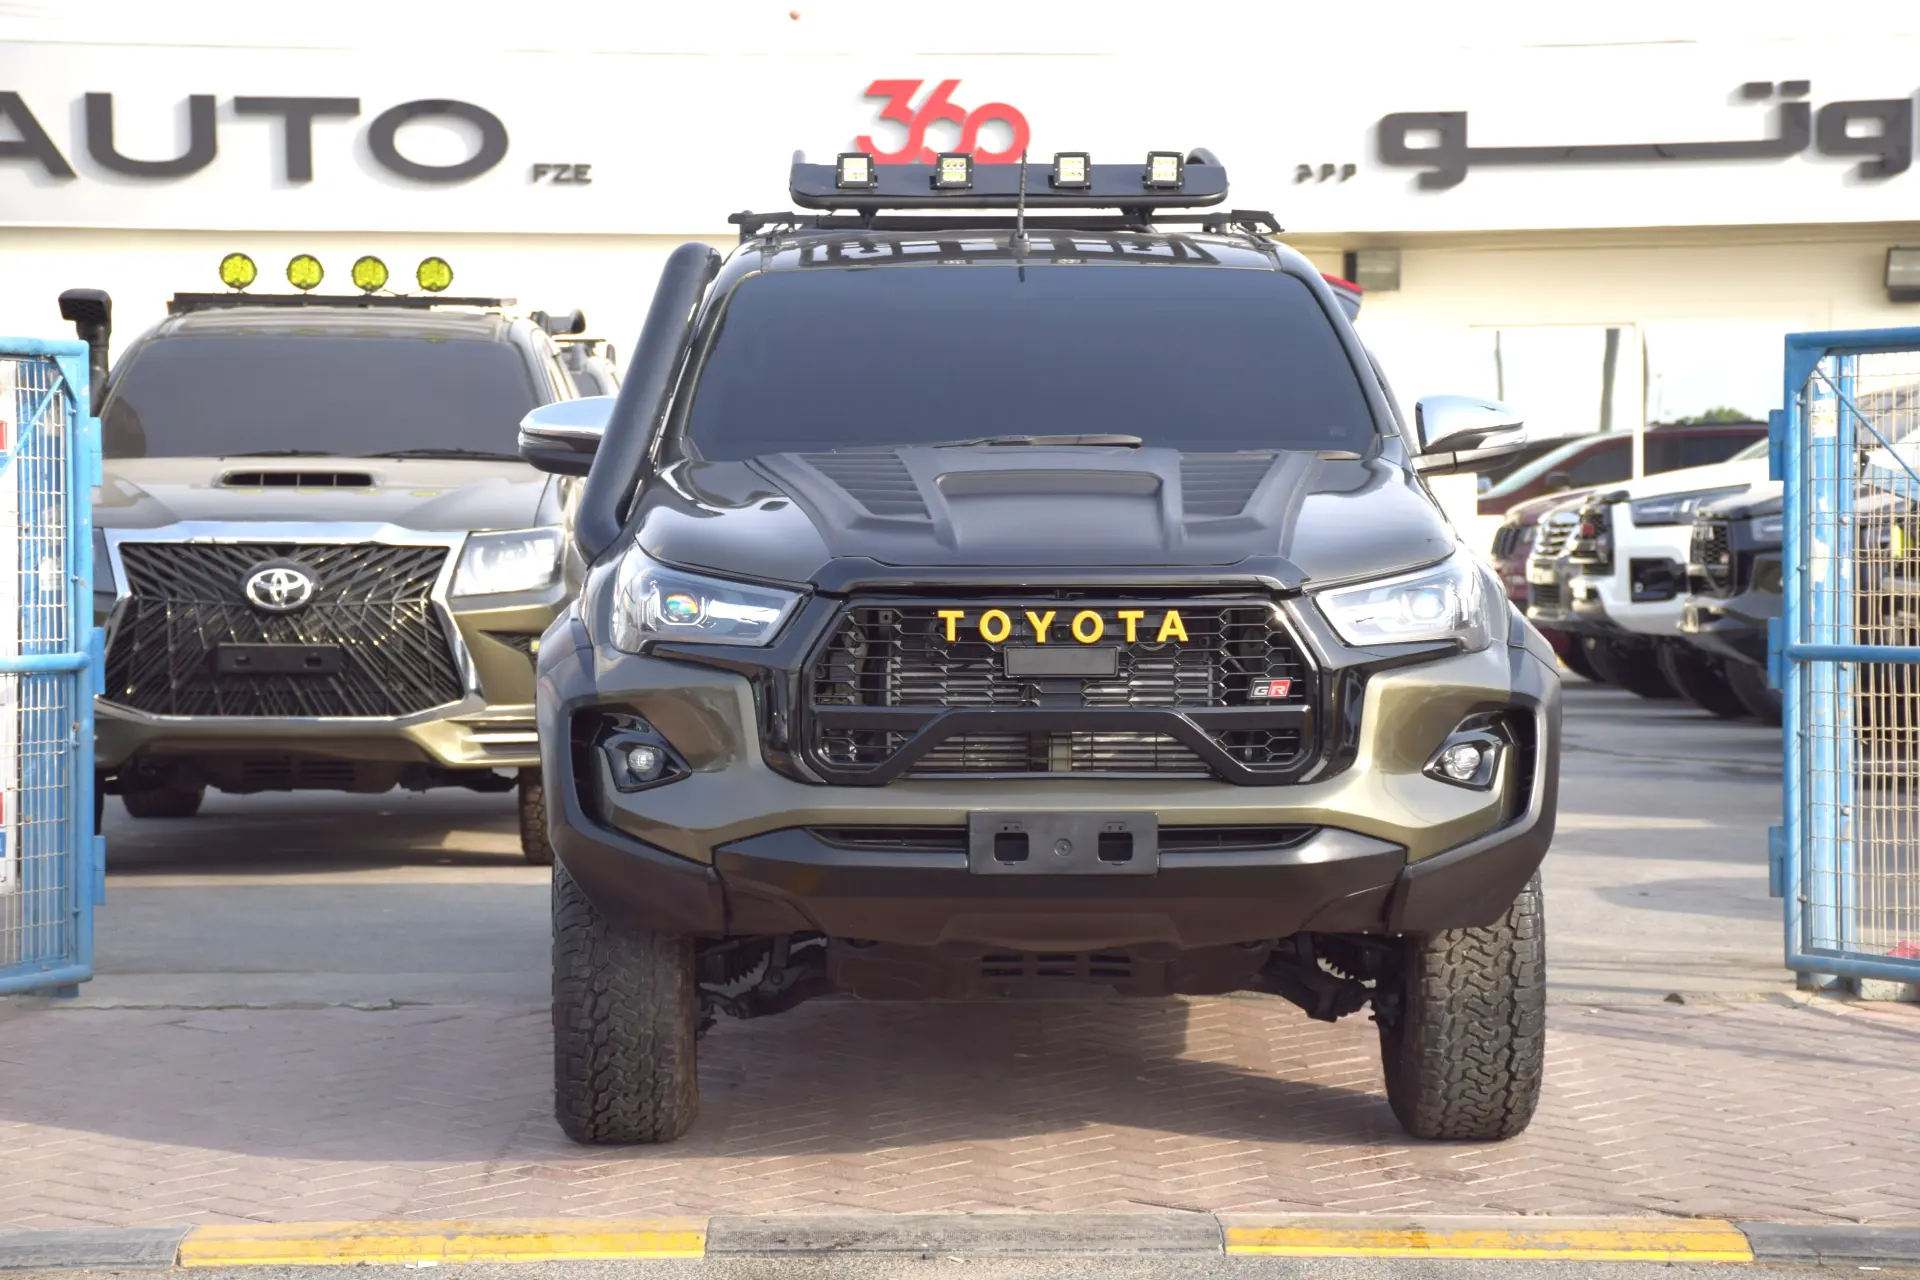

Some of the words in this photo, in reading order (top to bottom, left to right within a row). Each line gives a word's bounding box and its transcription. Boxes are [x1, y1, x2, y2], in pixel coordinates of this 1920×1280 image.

[0, 91, 509, 184] AUTO
[532, 163, 593, 184] FZE
[855, 78, 1031, 165] 360
[937, 609, 1189, 644] TOYOTA
[1253, 684, 1288, 696] GR
